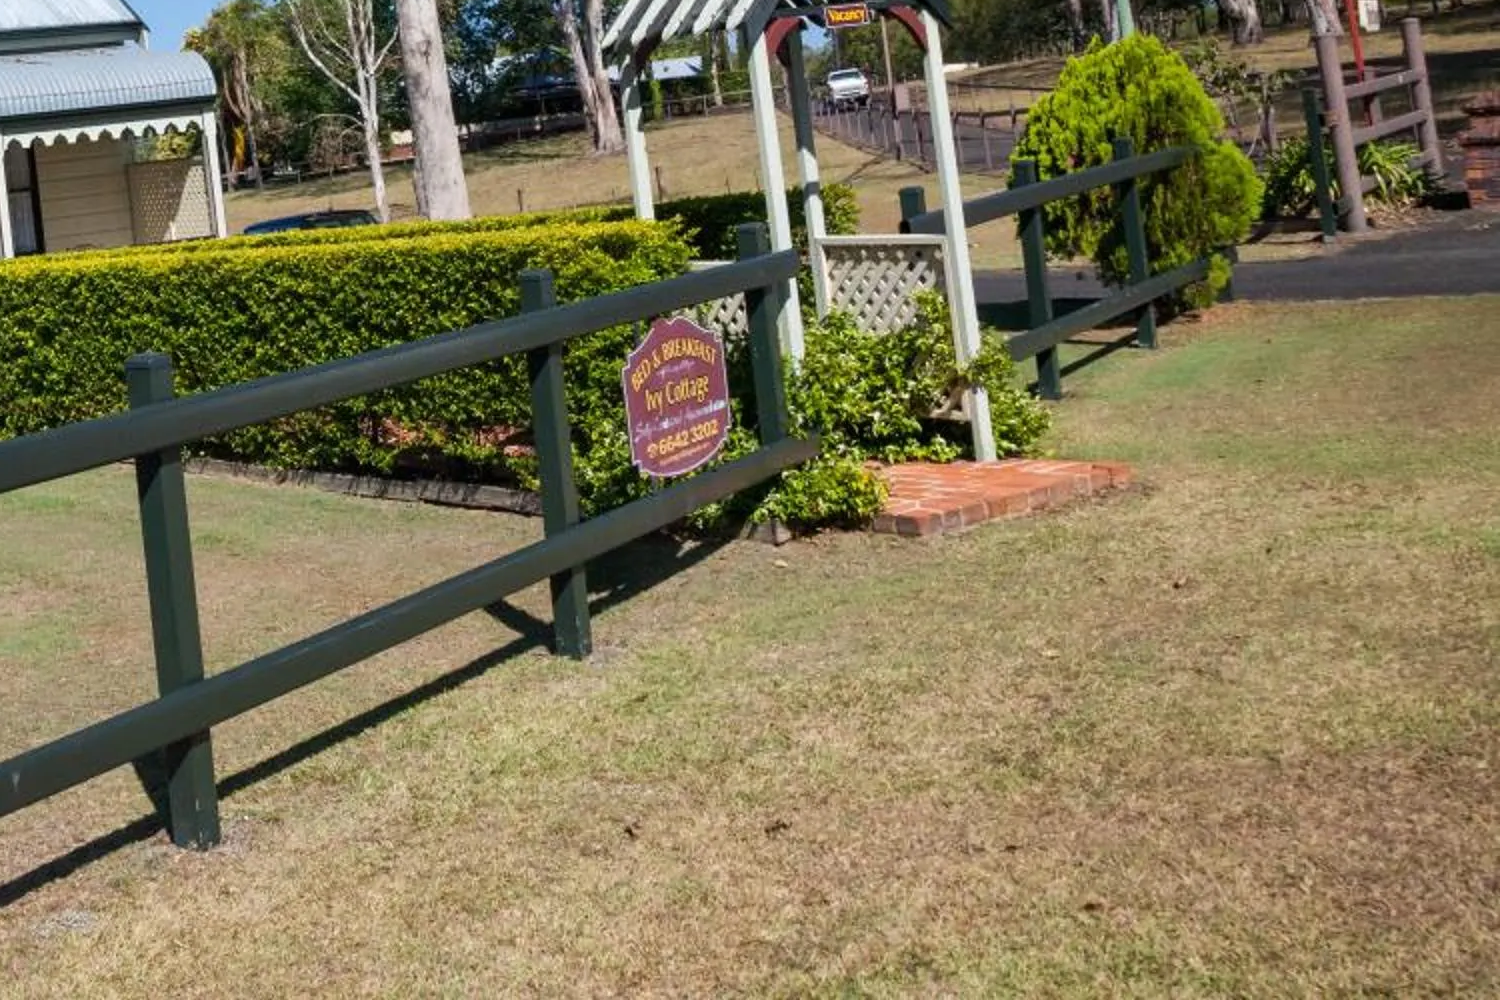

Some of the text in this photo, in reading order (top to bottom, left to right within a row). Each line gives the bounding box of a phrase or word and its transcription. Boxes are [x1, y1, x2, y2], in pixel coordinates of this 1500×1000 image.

[631, 359, 651, 392] BED
[662, 337, 716, 365] BREAKFAST
[645, 375, 709, 414] Ivy Cottage
[659, 430, 690, 455] 6642
